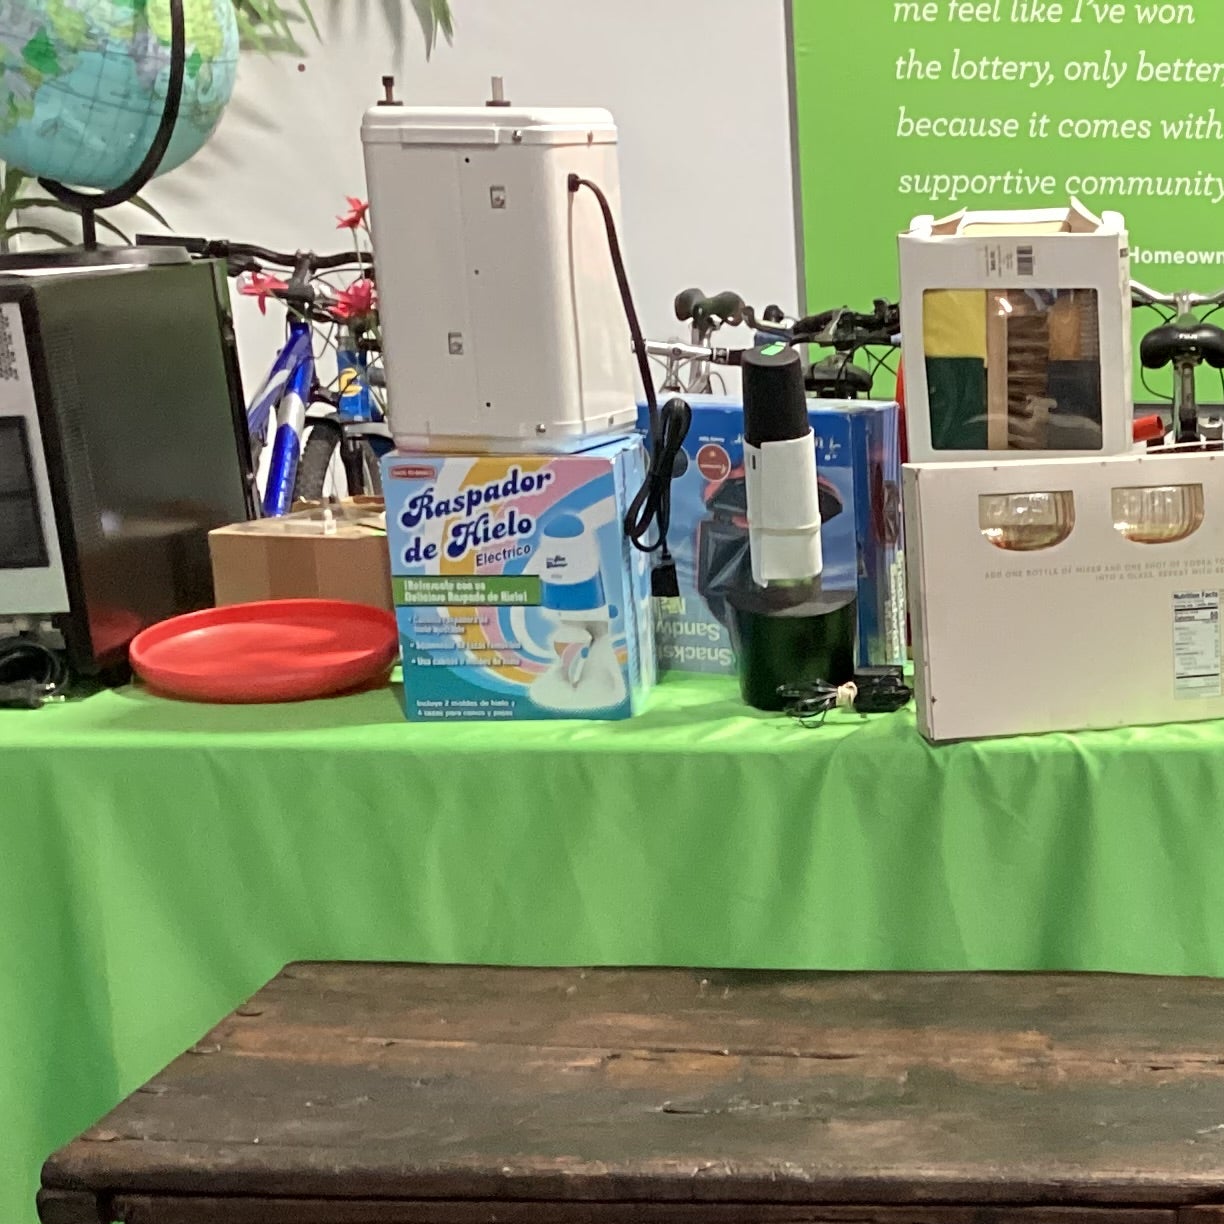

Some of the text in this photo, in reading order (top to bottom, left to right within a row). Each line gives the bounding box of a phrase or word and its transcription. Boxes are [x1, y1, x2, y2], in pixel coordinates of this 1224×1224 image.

[893, 1, 938, 22] me
[948, 0, 1001, 22] feel
[1010, 0, 1063, 23] like
[1135, 3, 1196, 24] won
[895, 48, 941, 80] the
[951, 48, 1055, 88] lottery,
[1064, 50, 1128, 88] only
[896, 106, 1019, 138] because
[1028, 112, 1050, 138] it
[1058, 118, 1151, 139] comes
[1160, 108, 1224, 140] with
[898, 168, 1056, 200] supportive
[401, 469, 552, 528] Raspador
[405, 511, 532, 564] de Hielo
[656, 621, 721, 642] Sandw
